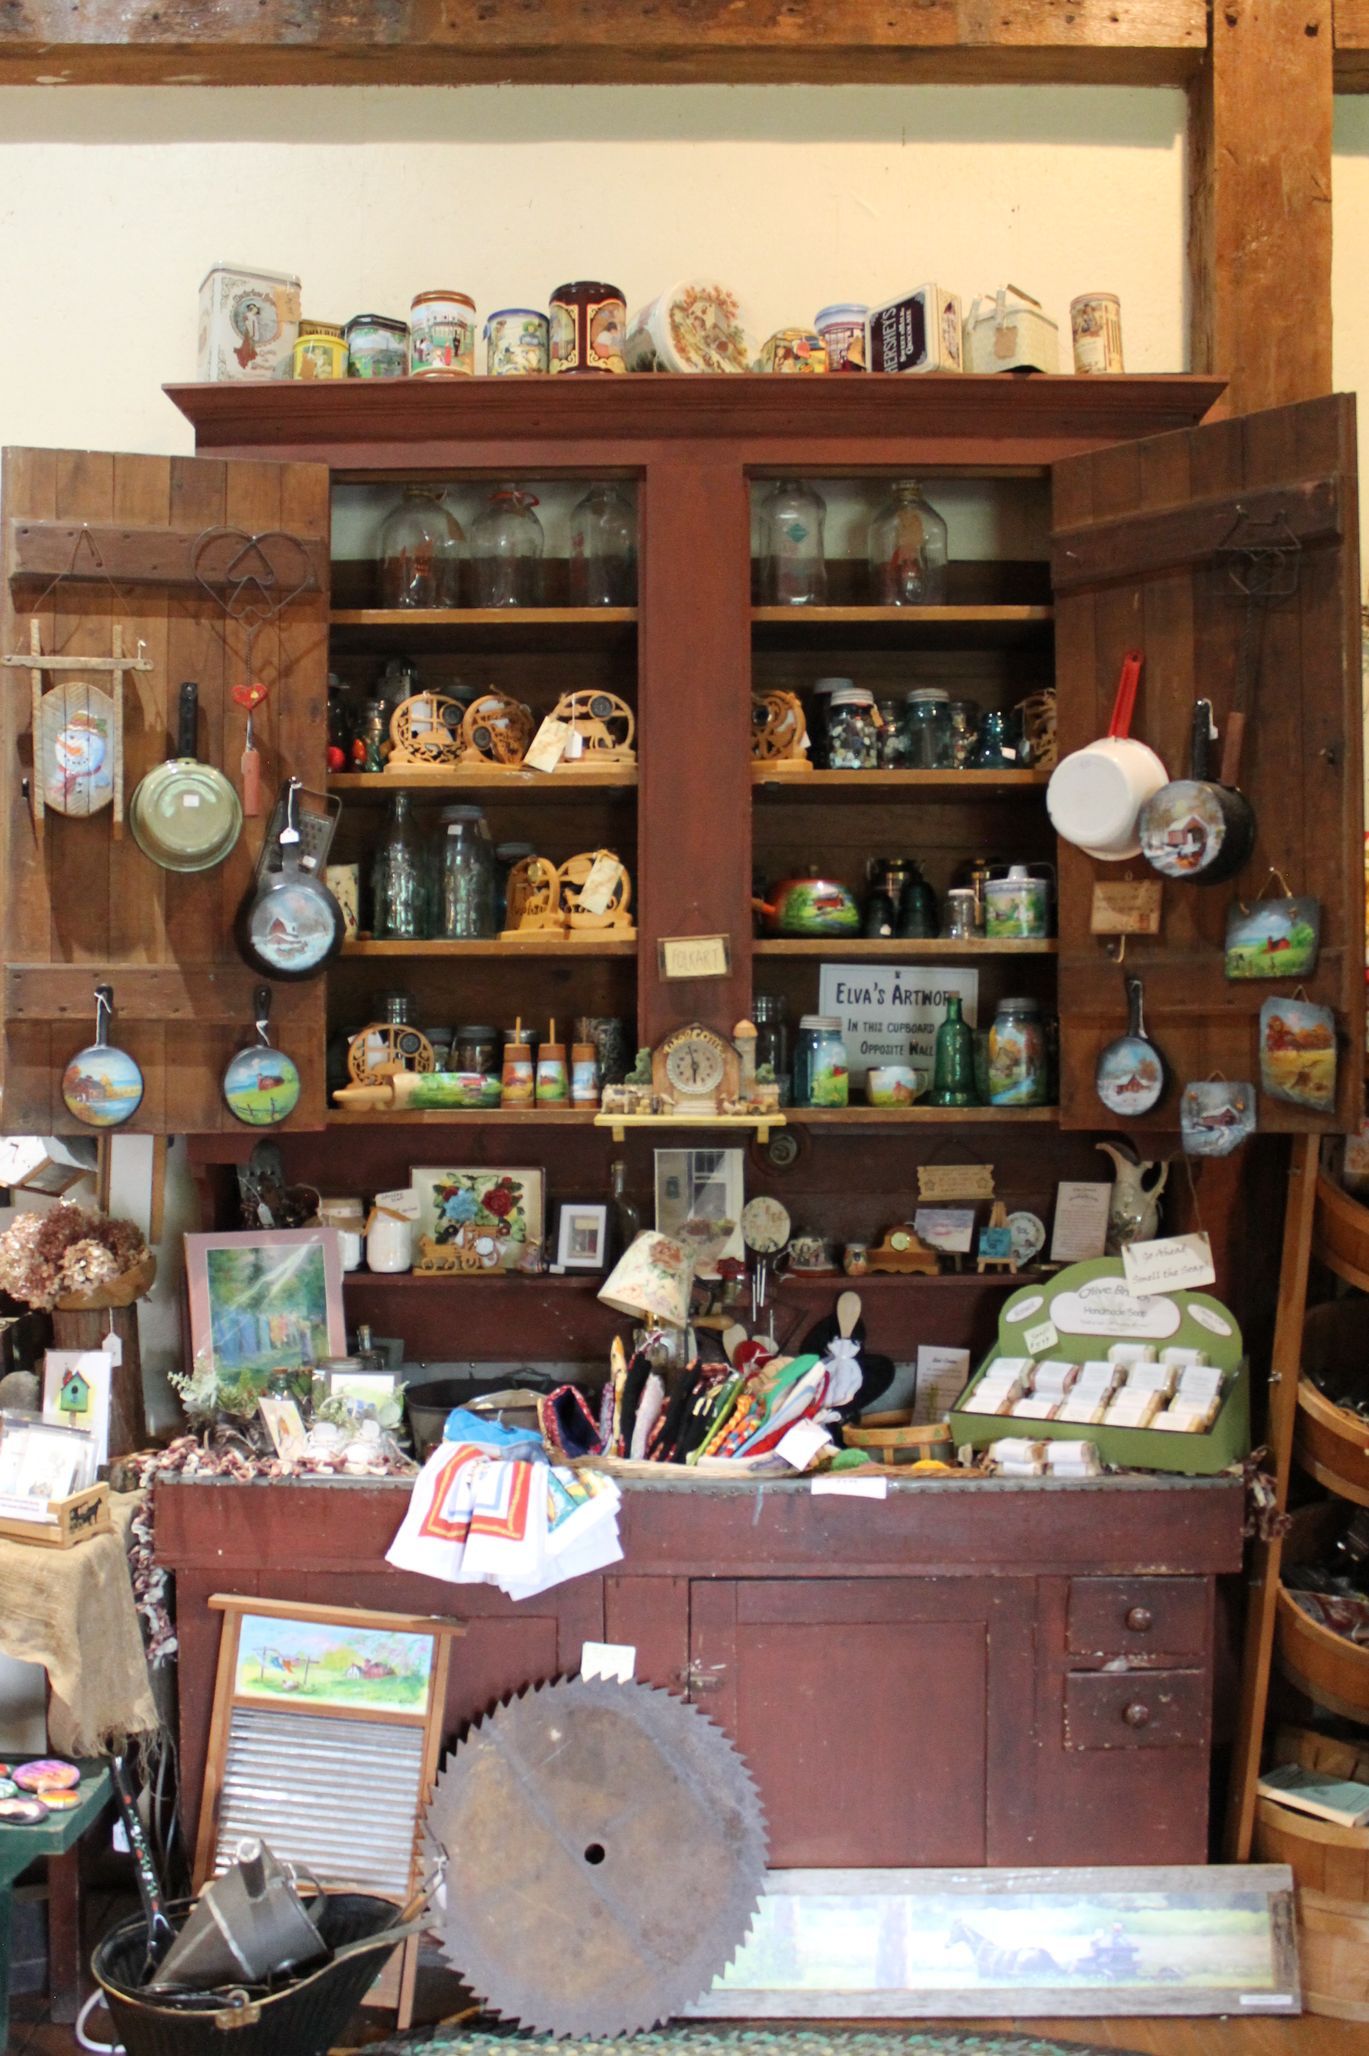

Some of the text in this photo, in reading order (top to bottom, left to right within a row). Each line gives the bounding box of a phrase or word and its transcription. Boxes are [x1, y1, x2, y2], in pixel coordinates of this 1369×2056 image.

[836, 981, 949, 1006] ELVA'S ARTWOR
[886, 1022, 935, 1034] CUPBOARD
[860, 1040, 904, 1056] OPPOSITE
[1132, 1265, 1206, 1284] Smell the Soap
